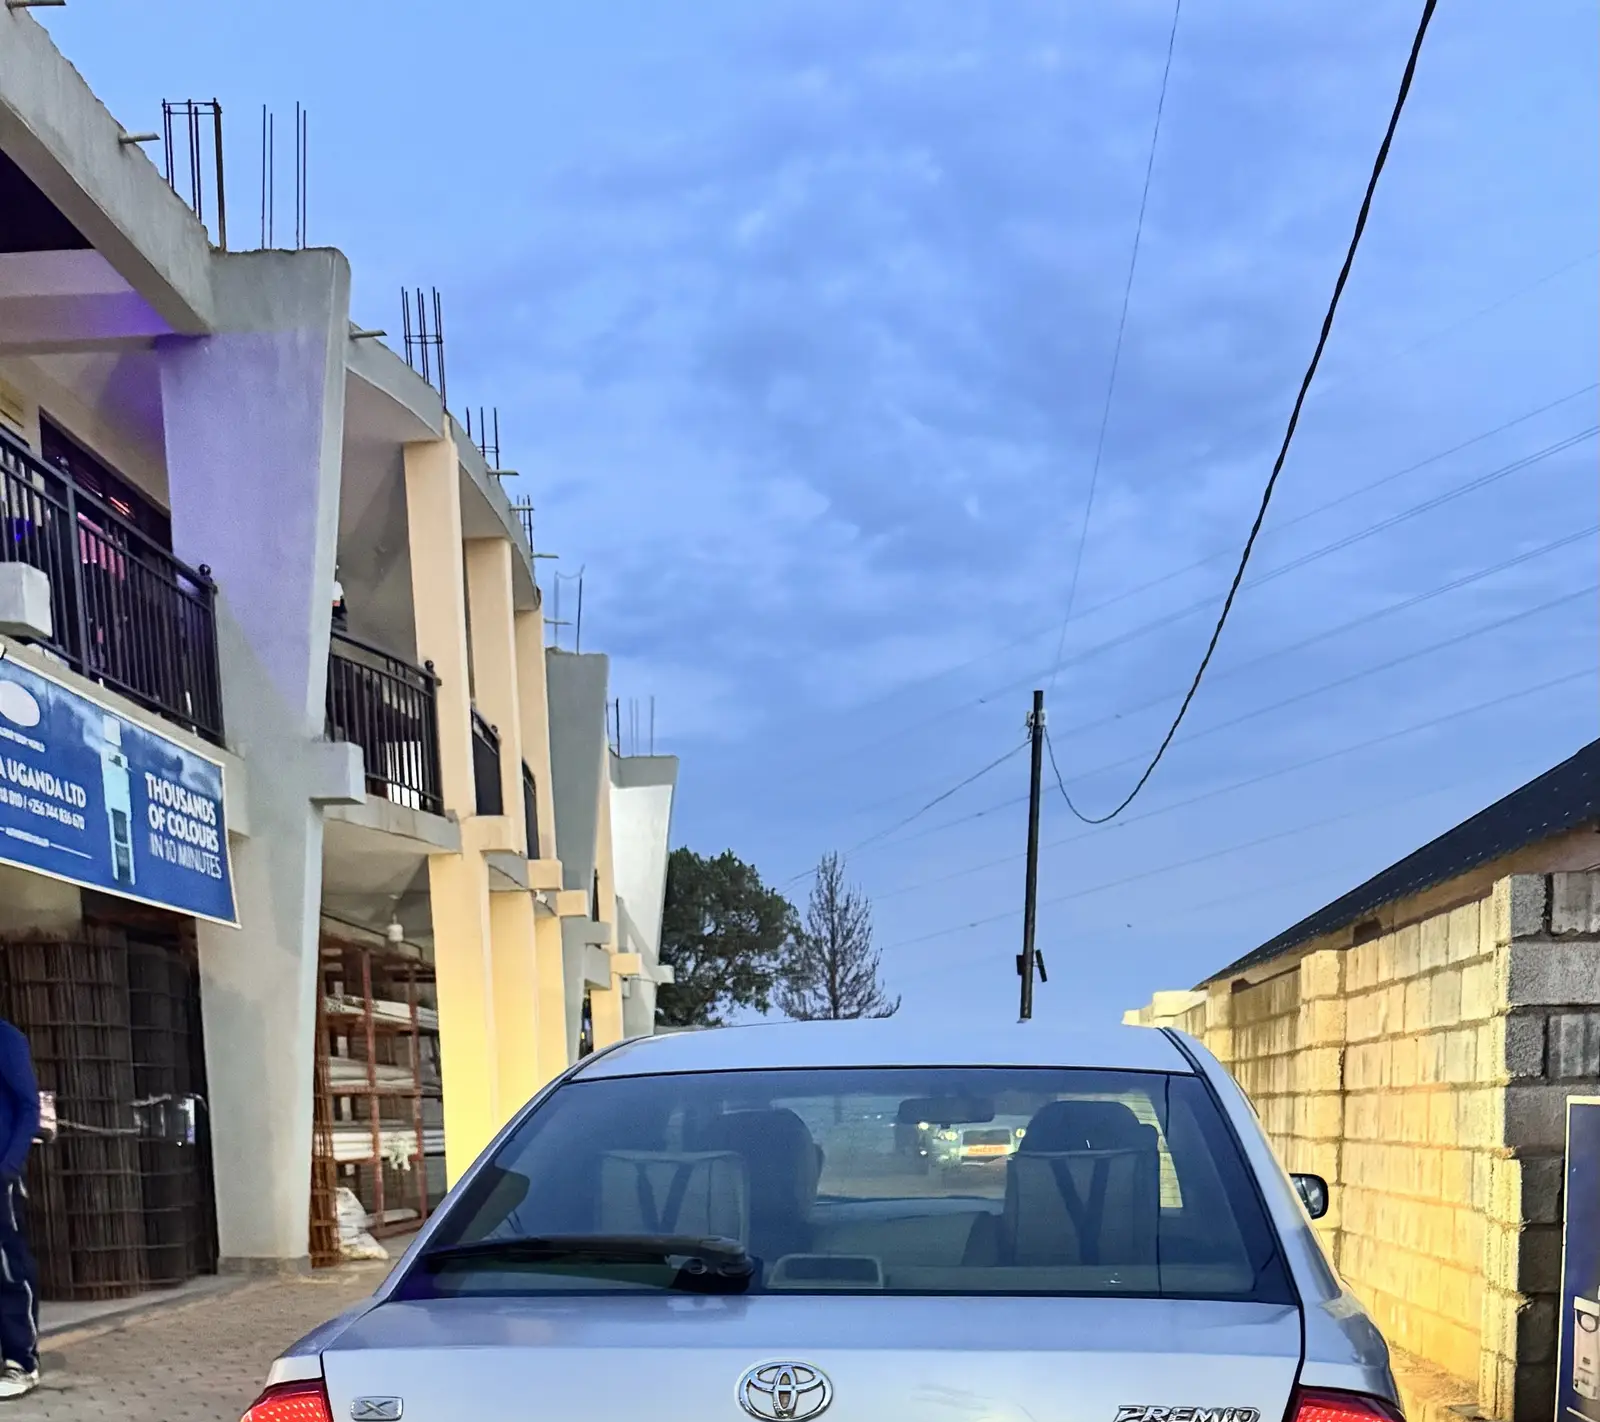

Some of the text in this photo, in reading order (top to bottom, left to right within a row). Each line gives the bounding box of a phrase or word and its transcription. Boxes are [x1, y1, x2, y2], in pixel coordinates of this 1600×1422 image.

[7, 758, 64, 800] UGANDA
[64, 781, 86, 808] LTD
[144, 771, 217, 826] THOUSANDS
[148, 803, 219, 853] OF COLOURS
[149, 833, 222, 879] IN 10 MINUTES
